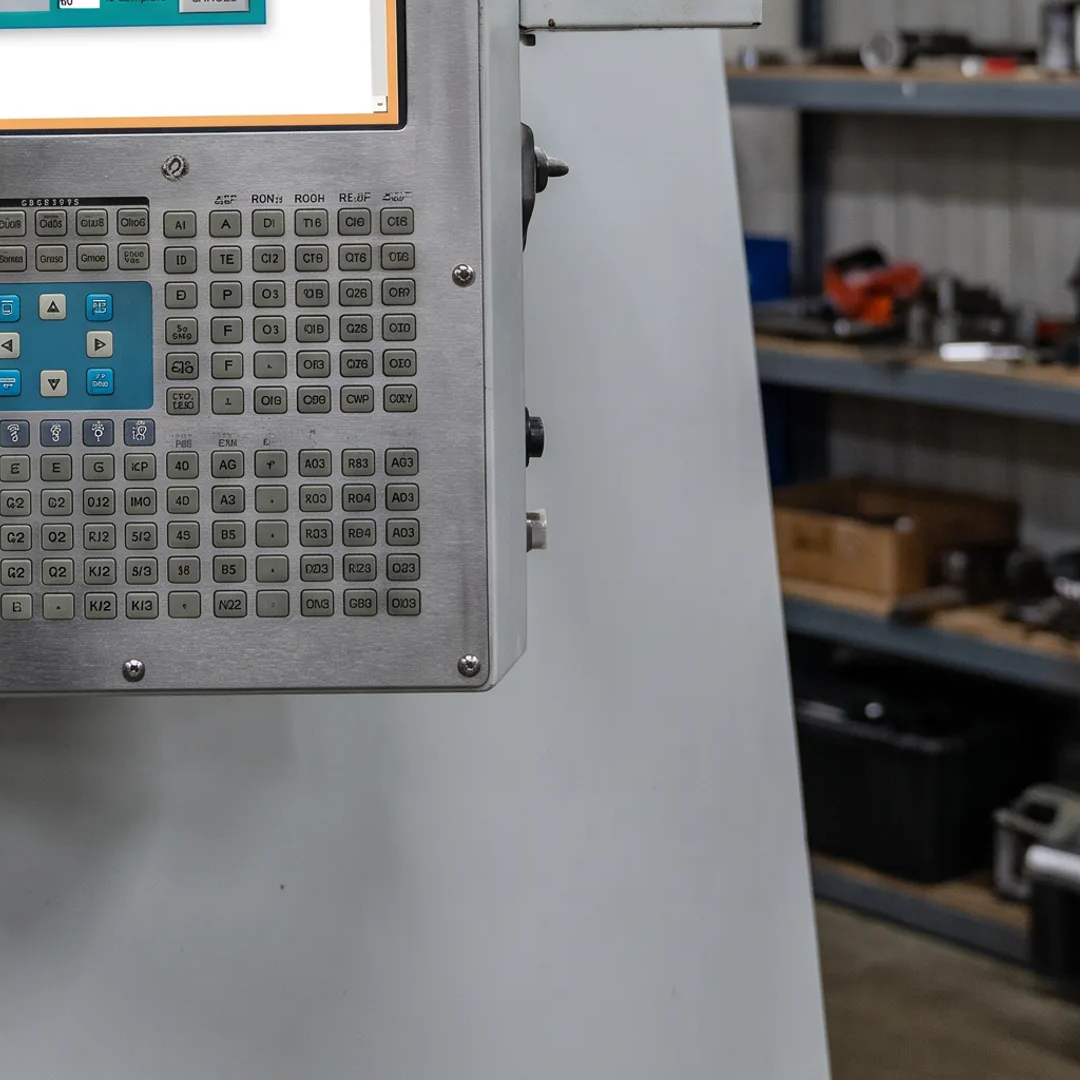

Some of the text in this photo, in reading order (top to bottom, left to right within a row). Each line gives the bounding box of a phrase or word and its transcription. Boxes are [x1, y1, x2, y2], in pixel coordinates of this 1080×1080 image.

[221, 219, 231, 229] A
[223, 289, 232, 300] P
[224, 325, 232, 336] F
[225, 360, 233, 371] F
[52, 463, 61, 473] E
